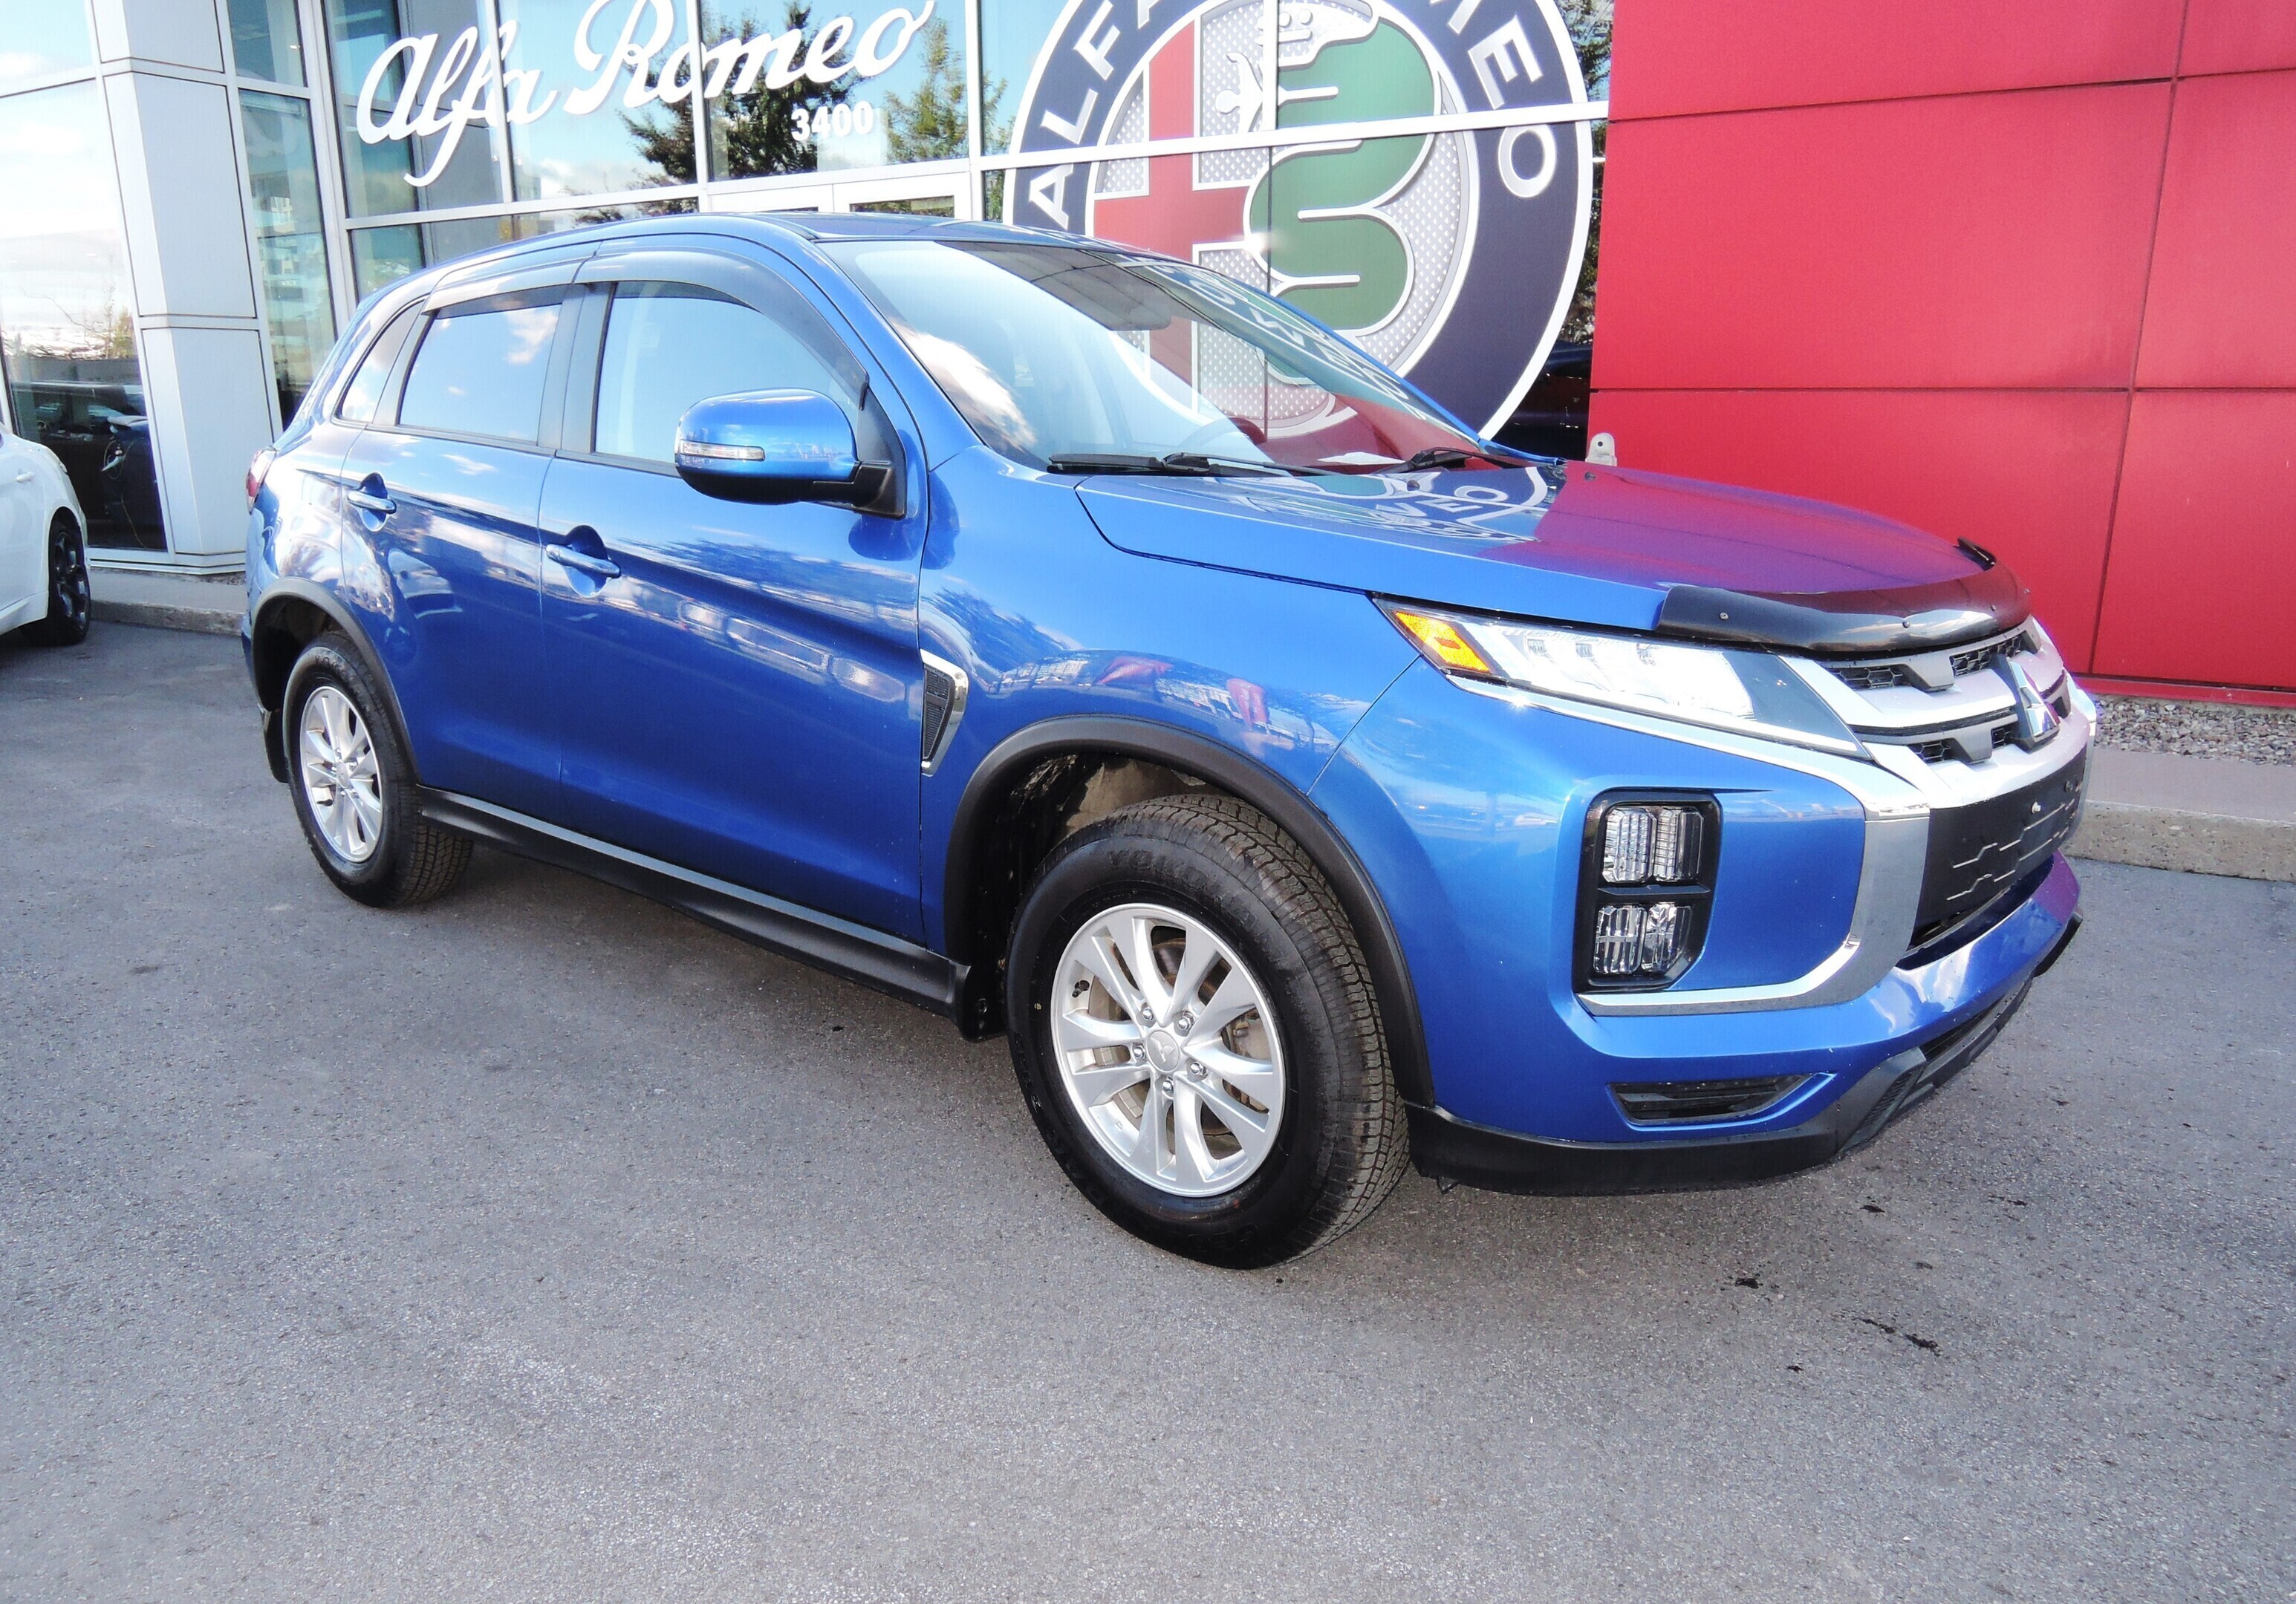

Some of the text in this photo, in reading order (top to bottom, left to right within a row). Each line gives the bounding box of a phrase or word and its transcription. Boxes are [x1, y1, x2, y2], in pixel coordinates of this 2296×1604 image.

[356, 0, 936, 187] Alfa Romeo
[790, 100, 874, 142] 3400
[1027, 0, 1162, 230] ALF
[1428, 0, 1558, 198] EO
